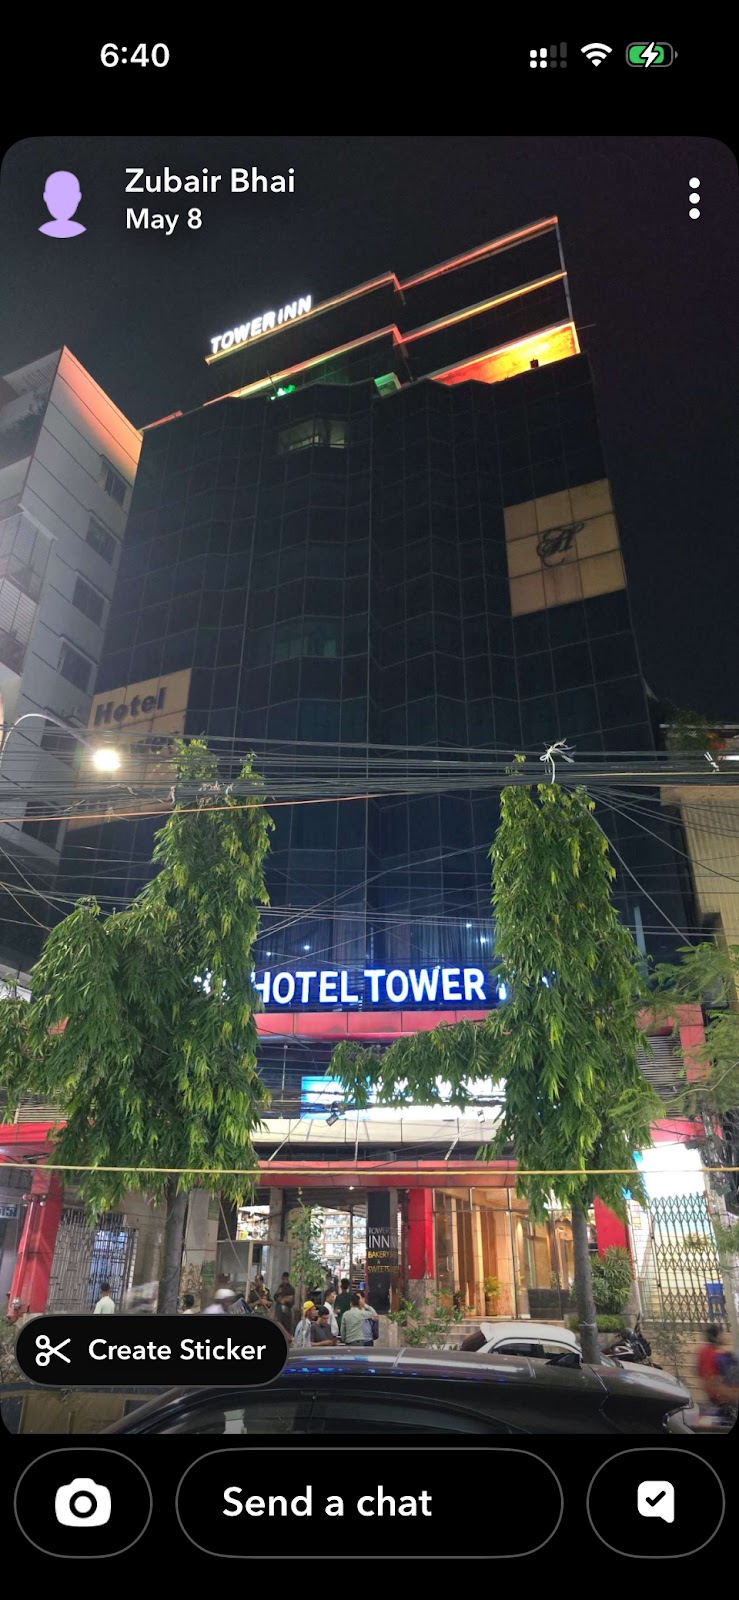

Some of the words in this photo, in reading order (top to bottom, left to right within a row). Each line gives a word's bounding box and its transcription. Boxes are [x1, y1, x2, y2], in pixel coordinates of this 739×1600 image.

[210, 311, 276, 354] TOWER
[278, 295, 312, 325] INN
[94, 687, 168, 727] Hotel
[251, 971, 359, 1004] HOTEL
[364, 967, 486, 1002] TOWER
[368, 1235, 390, 1249] INN
[367, 1251, 390, 1259] BAKERY
[367, 1265, 391, 1273] SWEETS
